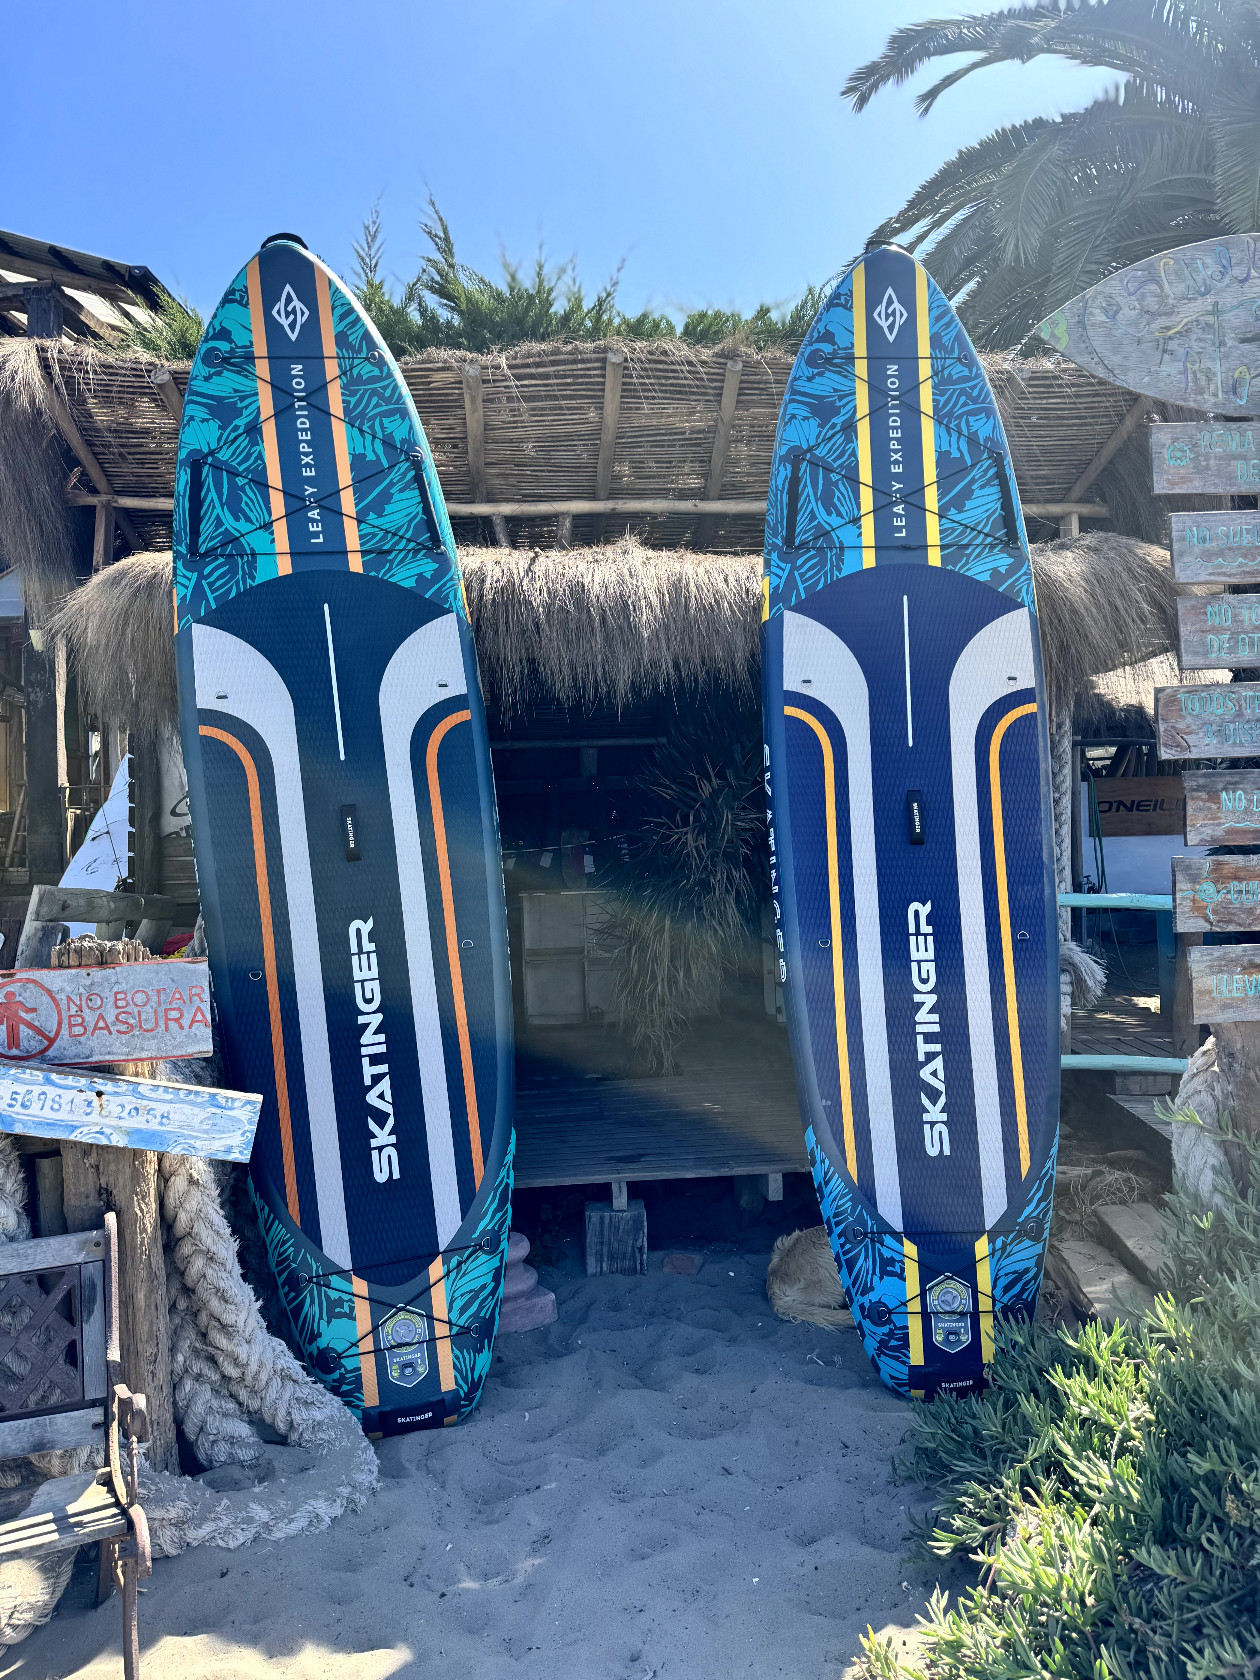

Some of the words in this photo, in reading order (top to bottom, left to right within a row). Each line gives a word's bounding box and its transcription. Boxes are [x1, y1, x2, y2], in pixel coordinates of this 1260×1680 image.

[290, 364, 316, 477] EXPEDITION
[886, 363, 904, 473] EXPEDITION
[303, 484, 324, 543] LEAFY
[892, 481, 907, 537] LEAFY
[1186, 526, 1210, 549] NO
[1207, 603, 1232, 626] NO
[1207, 634, 1230, 658] DE
[1177, 692, 1236, 716] TODOS
[1204, 723, 1216, 744] A
[1221, 790, 1245, 812] NO
[66, 992, 104, 1013] NO
[113, 985, 206, 1010] BOTAR
[67, 1006, 211, 1038] BASURA
[907, 899, 951, 1157] SKATINGER
[348, 915, 401, 1184] SKATINGER
